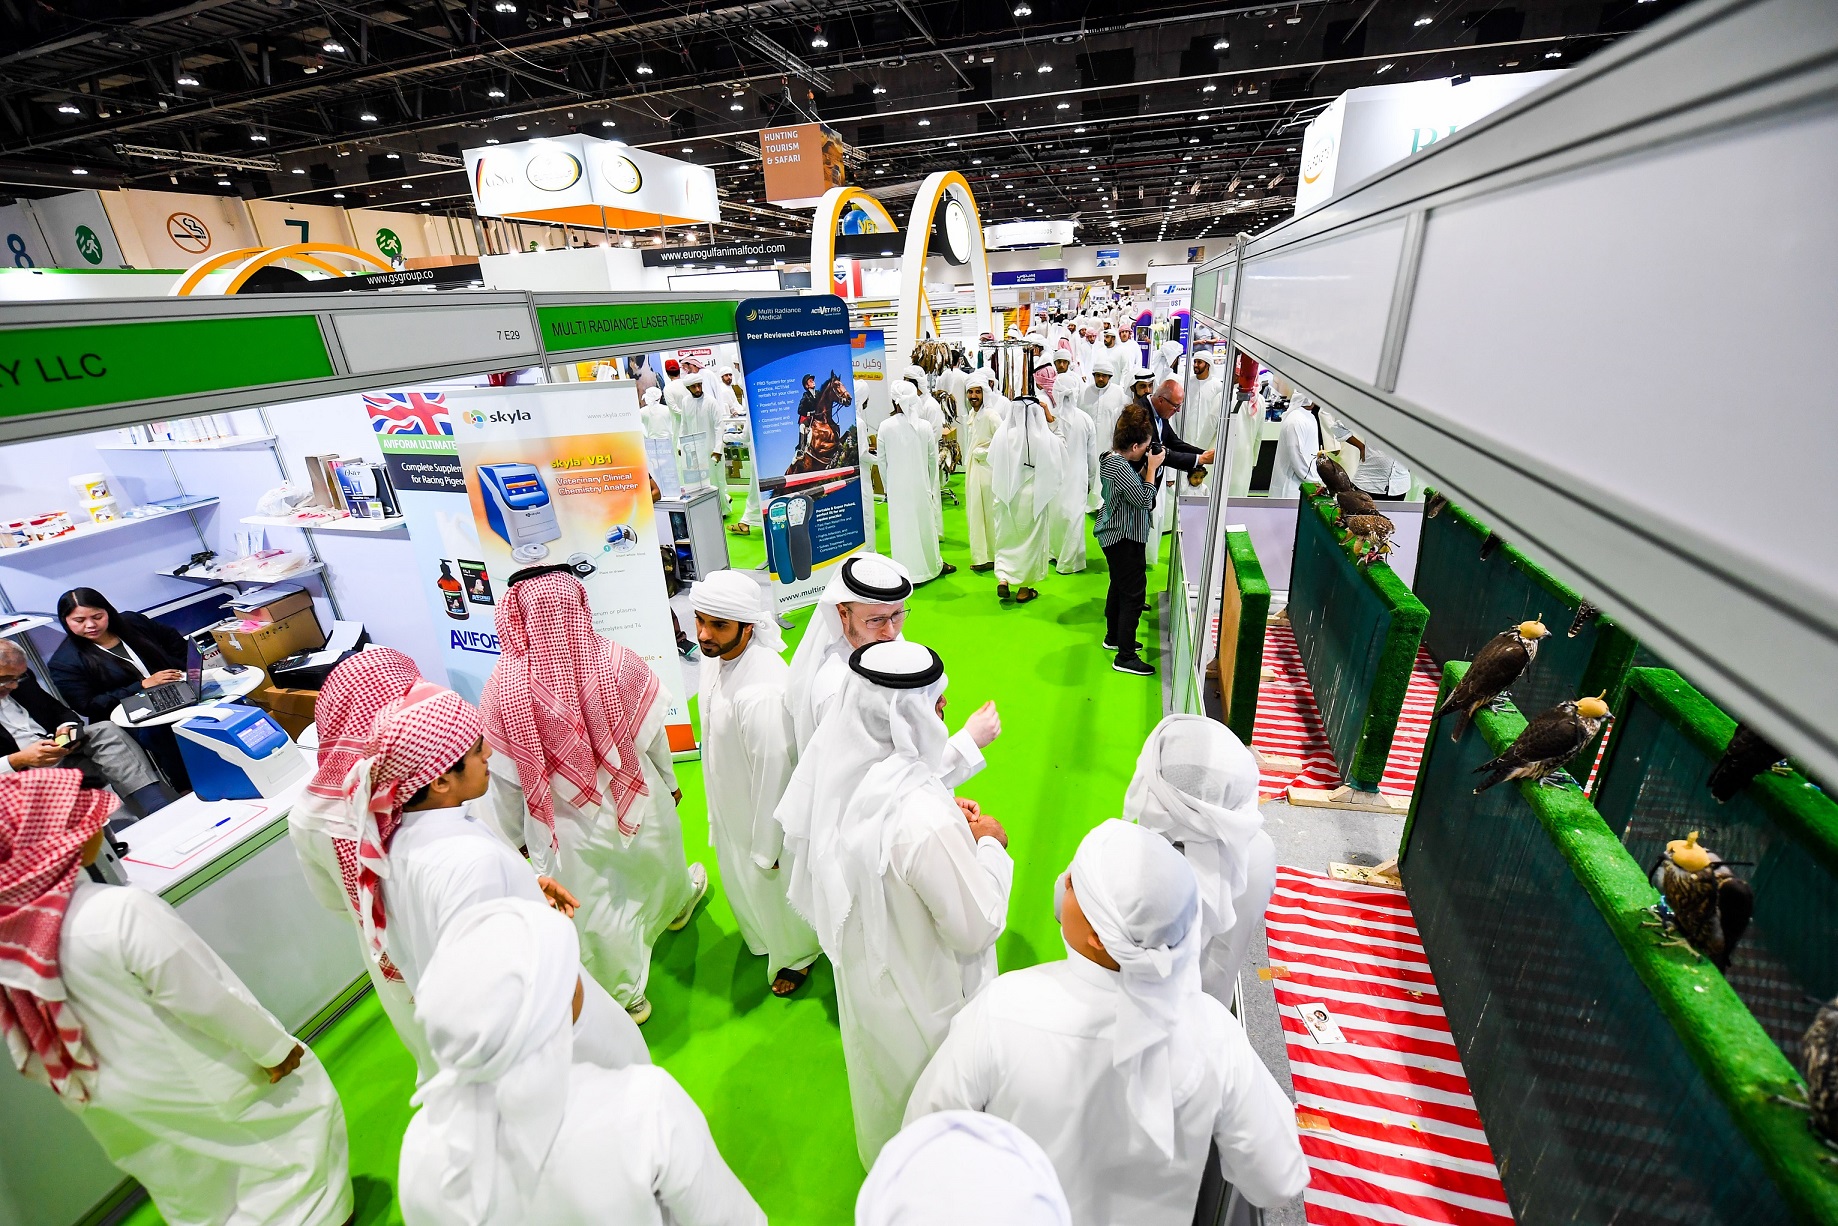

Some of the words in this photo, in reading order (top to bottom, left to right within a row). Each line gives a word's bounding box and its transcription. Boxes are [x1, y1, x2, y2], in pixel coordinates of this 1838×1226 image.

[764, 130, 798, 142] HUNTING
[765, 142, 800, 153] TOURISM
[766, 157, 773, 165] &
[774, 154, 801, 164] SAFARI
[7, 233, 35, 268] 8
[660, 243, 786, 261] www.eurogulfanimalfood.com
[366, 270, 434, 286] www.gsgroup.co
[758, 307, 774, 315] Multi
[551, 320, 587, 338] MULTI
[589, 317, 639, 334] RADIANCE
[640, 315, 669, 329] LASER
[670, 313, 704, 326] THERAPY
[496, 330, 502, 340] 7
[504, 330, 521, 340] E29
[746, 332, 763, 340] Peer
[763, 330, 796, 339] Reviewed
[796, 329, 822, 337] Practice
[0, 358, 21, 386] Y
[35, 353, 108, 382] LLC
[862, 358, 882, 370] وكيل
[489, 409, 532, 424] skyla
[587, 411, 632, 419] www.skyla.com
[383, 439, 418, 449] AVIFORM
[418, 440, 458, 450] ULTIMATE
[586, 454, 613, 466] VB1
[401, 462, 435, 473] Complete
[434, 463, 462, 475] Supplem
[410, 474, 422, 483] for
[421, 475, 445, 486] Racing
[444, 476, 466, 487] Pigeo
[555, 475, 602, 486] Veterinary
[602, 473, 633, 482] Clinical
[557, 483, 602, 496] Chemistry
[603, 481, 639, 492] Analyzer
[778, 585, 826, 603] www.multira
[616, 607, 637, 615] plasma
[594, 625, 623, 633] lectrolytes
[450, 629, 501, 650] AVIFOR
[203, 649, 222, 661] Can
